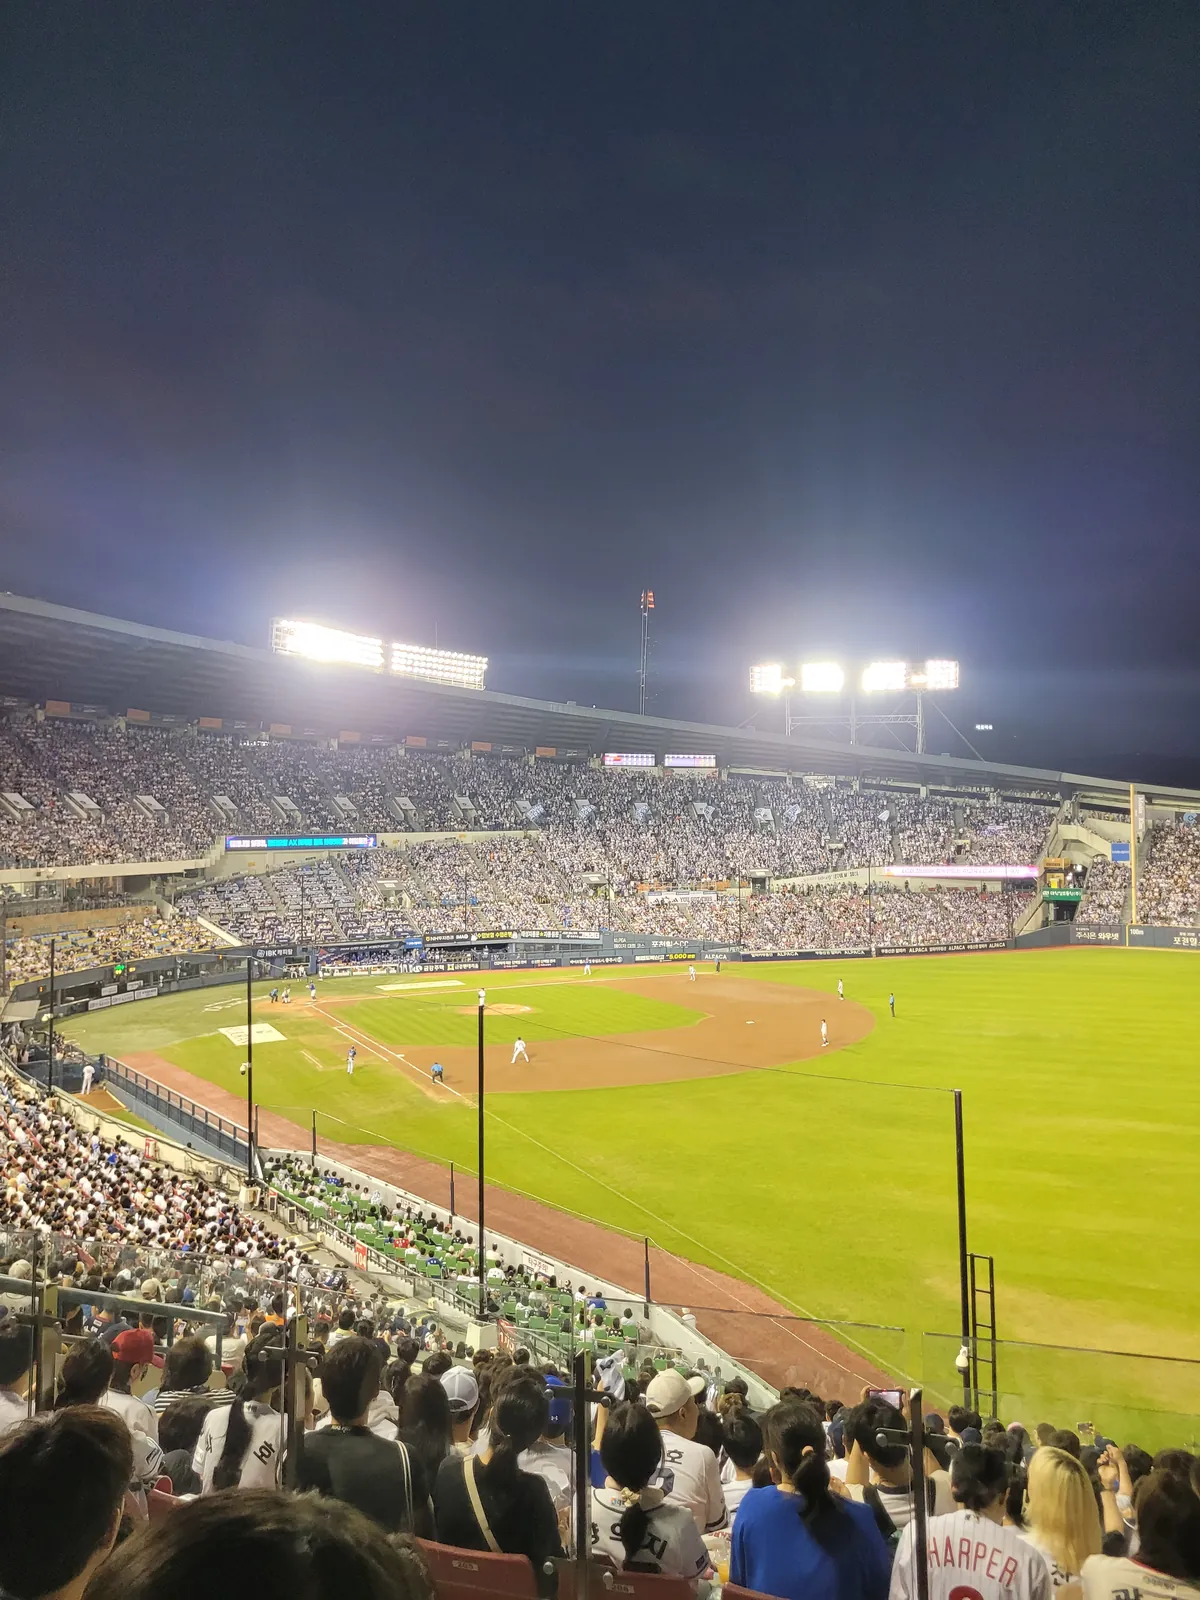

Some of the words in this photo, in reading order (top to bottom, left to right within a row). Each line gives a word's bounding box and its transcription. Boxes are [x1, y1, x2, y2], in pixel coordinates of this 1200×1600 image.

[1129, 928, 1144, 936] 100m
[1173, 936, 1200, 947] 포천힐
[928, 1535, 1018, 1588] HARPER
